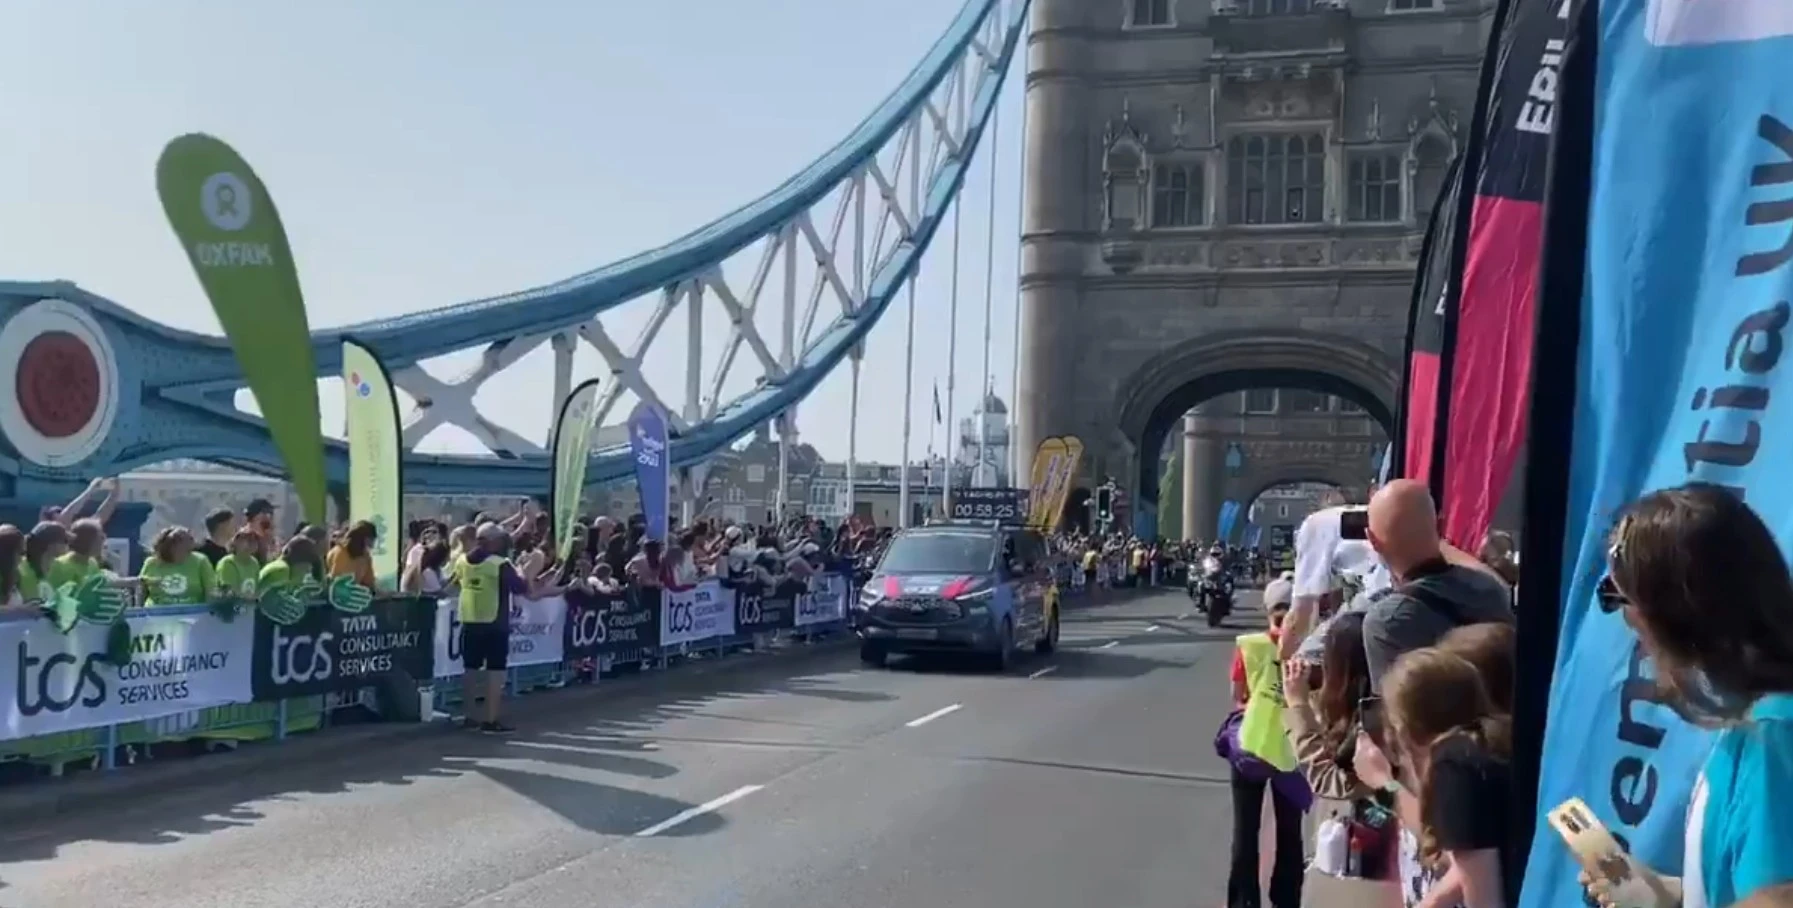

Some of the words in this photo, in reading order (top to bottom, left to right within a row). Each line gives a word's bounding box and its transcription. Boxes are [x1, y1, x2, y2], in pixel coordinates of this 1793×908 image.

[340, 615, 377, 633] TATA
[668, 593, 693, 633] tcs
[129, 632, 166, 654] ATA
[271, 624, 334, 685] tcs
[339, 630, 421, 655] CONSULTANCY
[17, 639, 109, 716] tcs
[117, 650, 230, 681] CONSULTANCY
[338, 654, 393, 677] SERVICES
[117, 680, 190, 706] SERVICES
